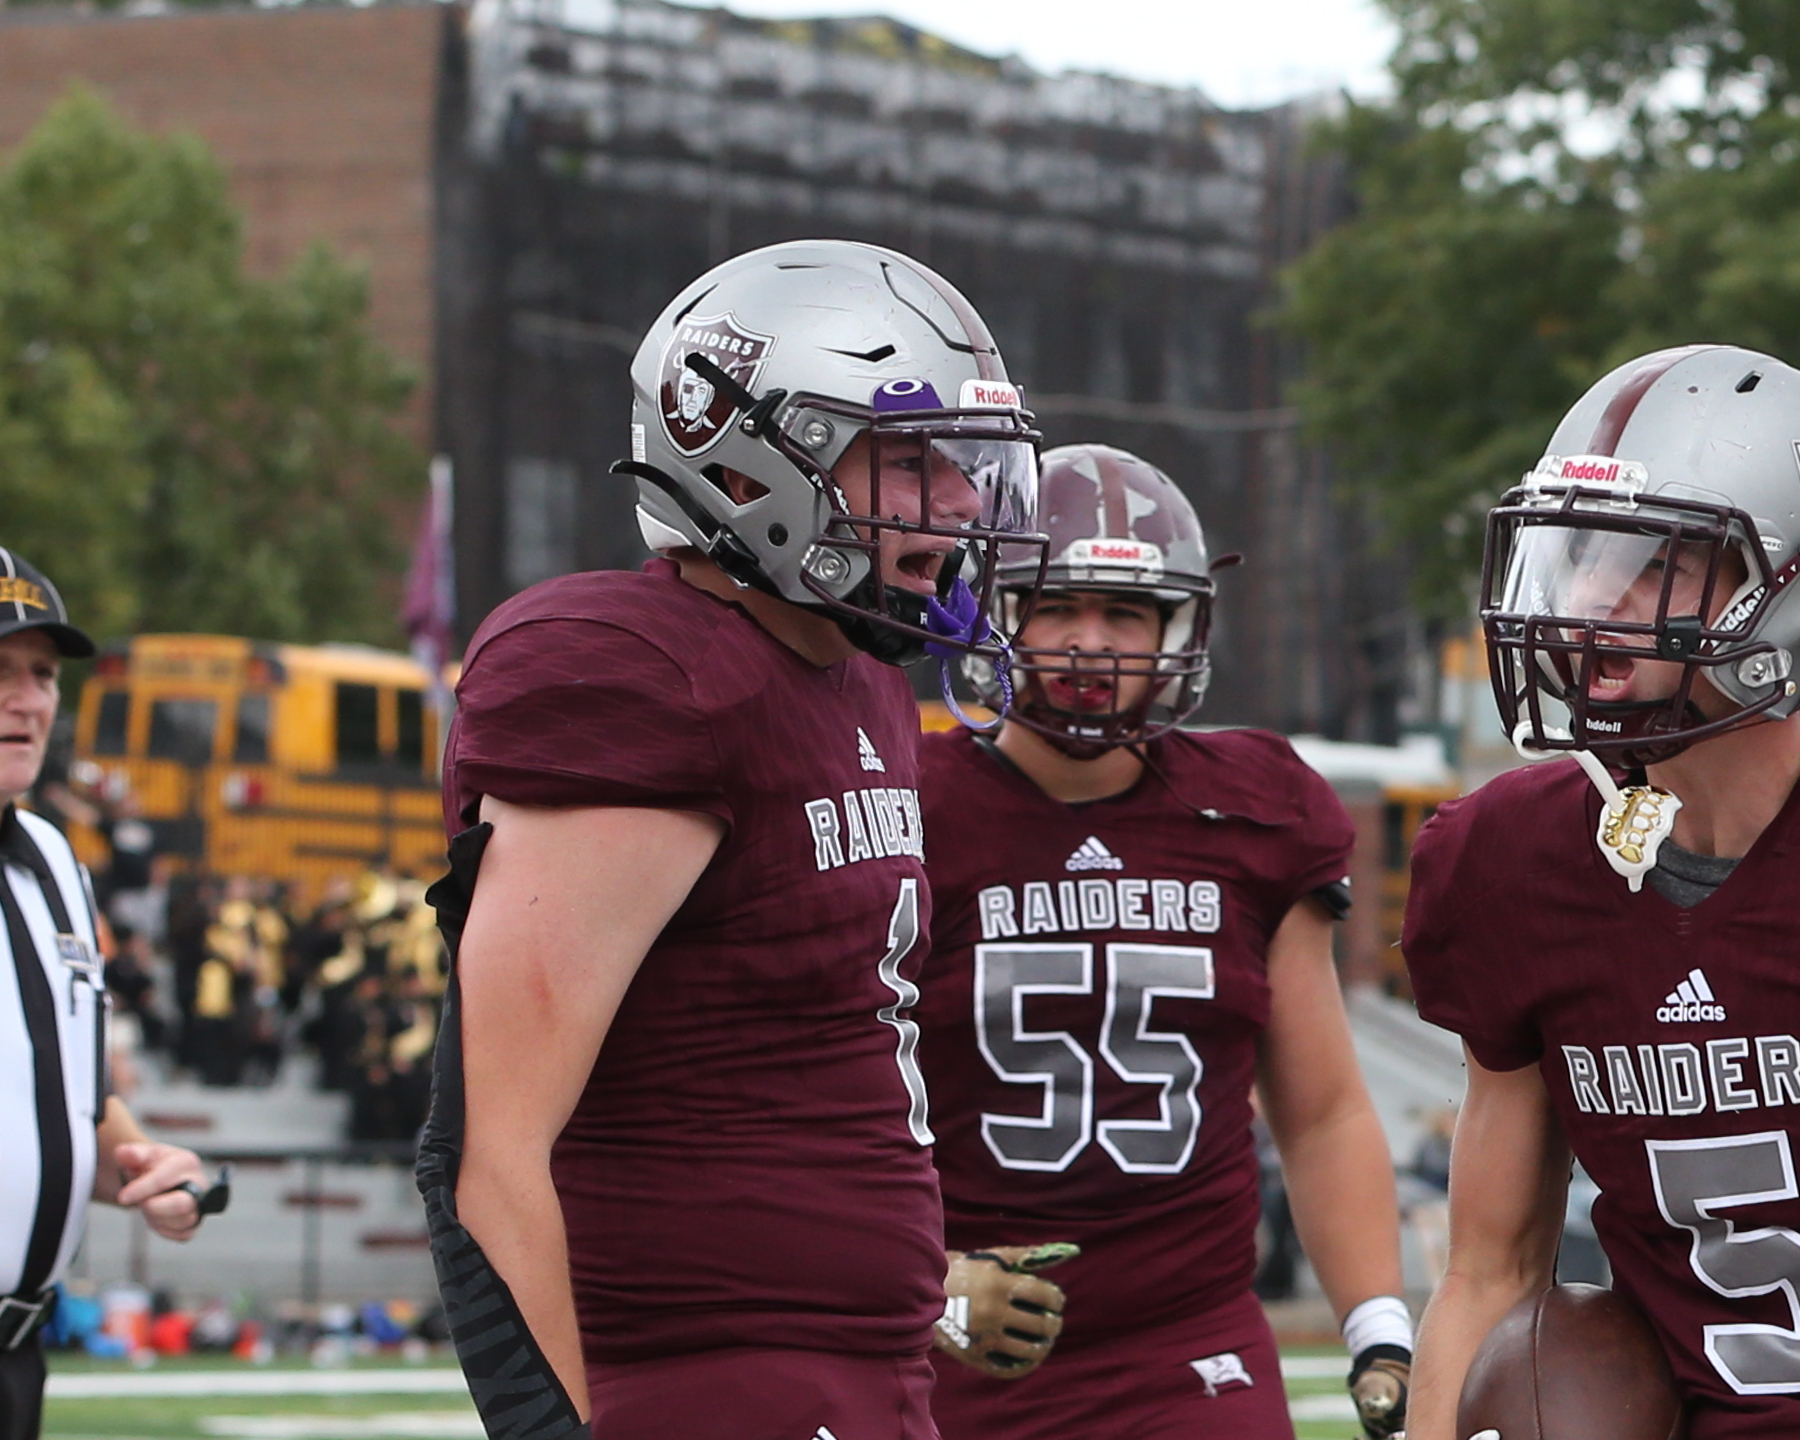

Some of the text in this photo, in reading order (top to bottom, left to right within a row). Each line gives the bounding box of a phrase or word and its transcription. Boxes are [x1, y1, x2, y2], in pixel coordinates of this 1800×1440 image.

[681, 327, 755, 356] RAIDERS
[1562, 460, 1619, 482] Riddell
[1090, 544, 1142, 561] Riddell
[977, 878, 1222, 940] RAIDERS
[1655, 1000, 1727, 1023] adidas
[974, 942, 1215, 1174] 55
